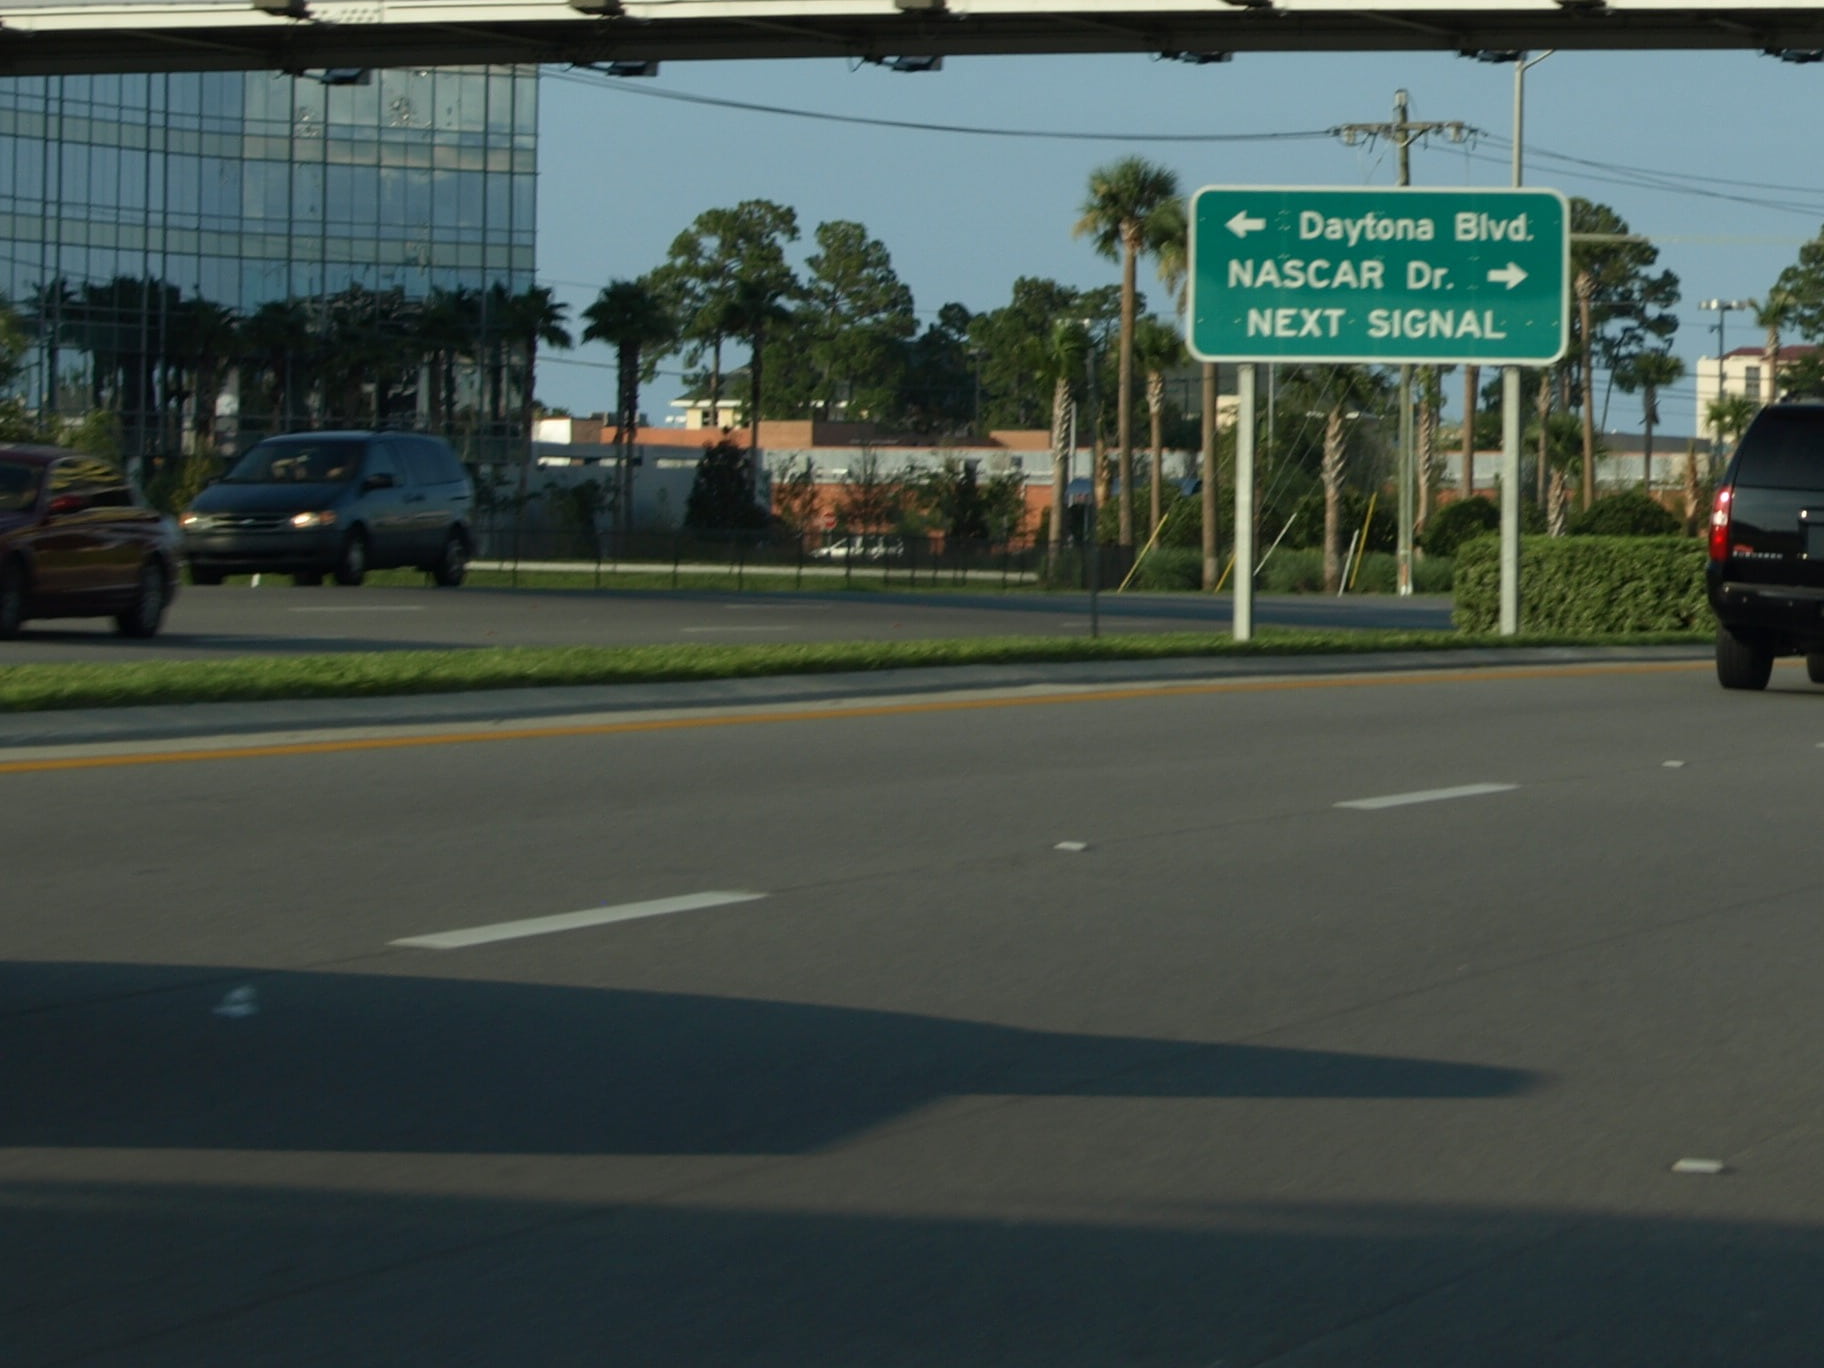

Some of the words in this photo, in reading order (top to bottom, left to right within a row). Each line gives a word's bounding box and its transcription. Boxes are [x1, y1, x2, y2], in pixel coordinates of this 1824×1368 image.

[1300, 211, 1434, 247] Daytona
[1456, 212, 1534, 241] Blvd.
[1228, 260, 1384, 289] NASCAR
[1407, 261, 1454, 289] Dr.
[1247, 308, 1346, 338] NEXT
[1368, 309, 1507, 339] SIGNAL
